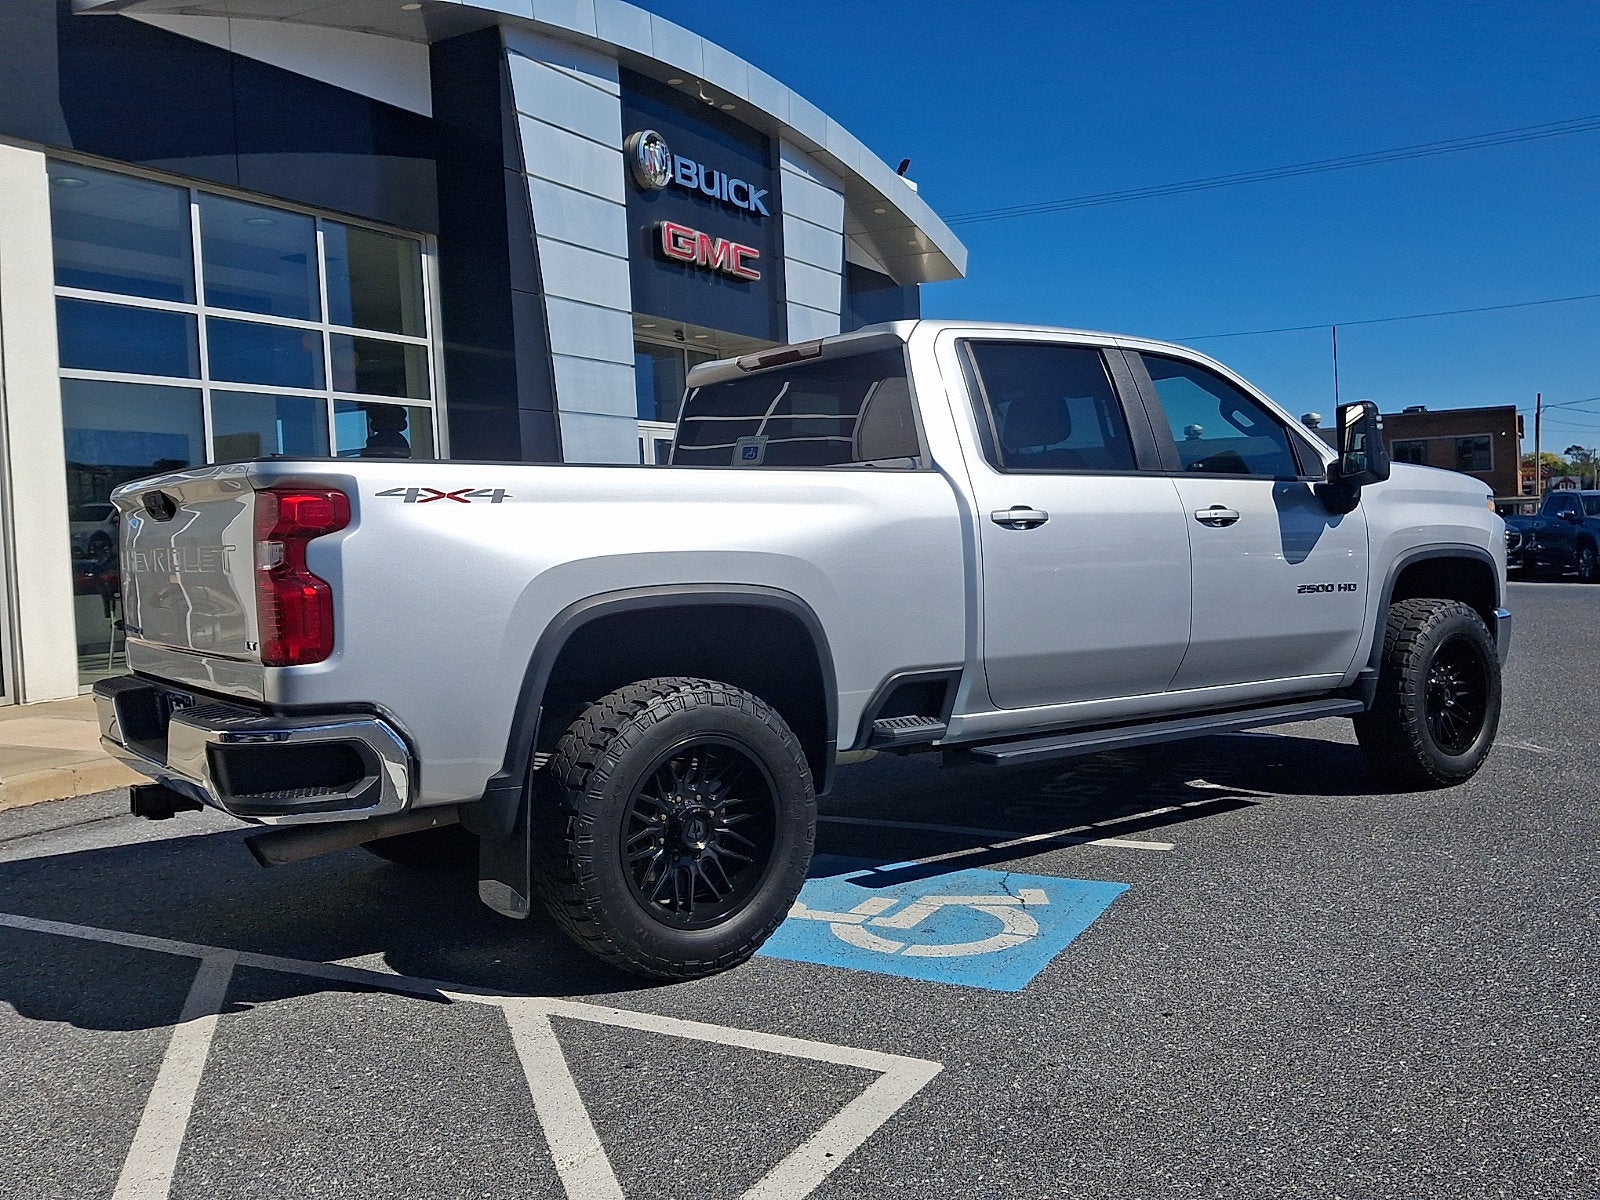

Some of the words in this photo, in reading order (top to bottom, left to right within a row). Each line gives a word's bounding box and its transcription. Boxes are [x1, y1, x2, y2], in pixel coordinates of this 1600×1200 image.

[673, 155, 770, 217] BUICK
[660, 220, 761, 281] GMC
[1297, 583, 1335, 594] 2500
[1337, 583, 1357, 593] HD
